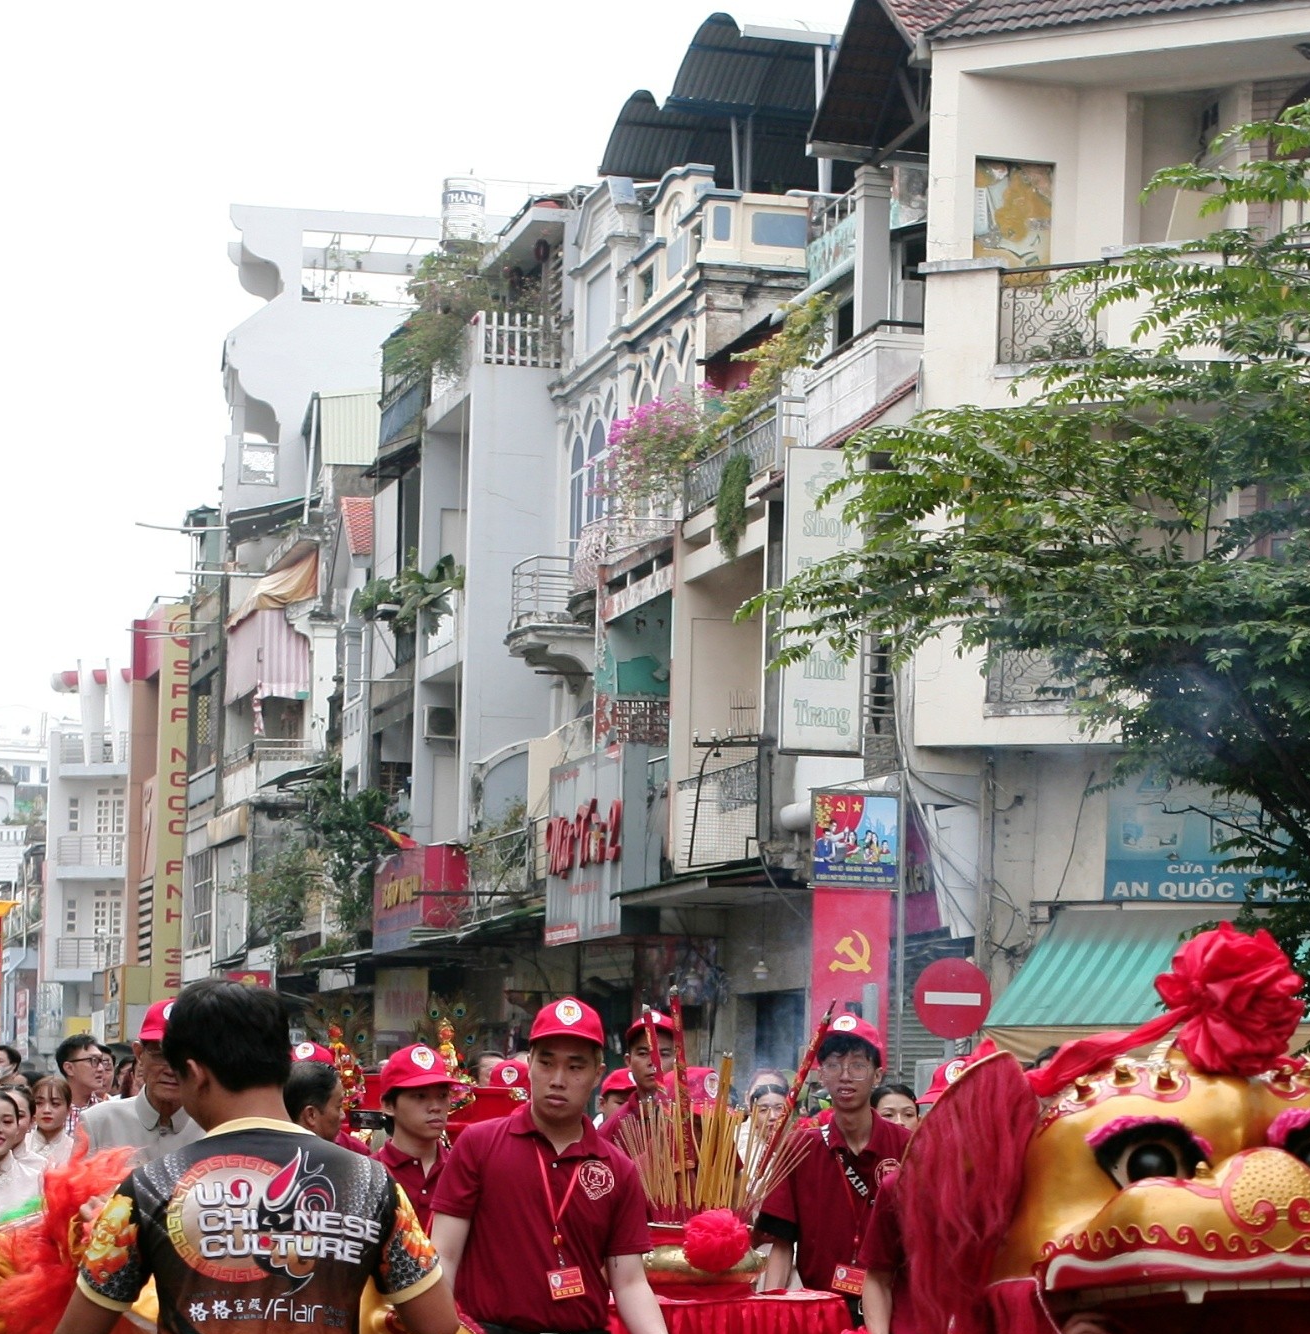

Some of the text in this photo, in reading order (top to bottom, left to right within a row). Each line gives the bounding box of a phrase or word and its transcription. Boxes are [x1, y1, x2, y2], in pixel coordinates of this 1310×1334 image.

[803, 510, 851, 546] Shop
[793, 699, 851, 736] Trang
[1112, 882, 1148, 899] AN
[1158, 875, 1235, 900] QUỐC
[199, 1234, 363, 1264] CULTURE
